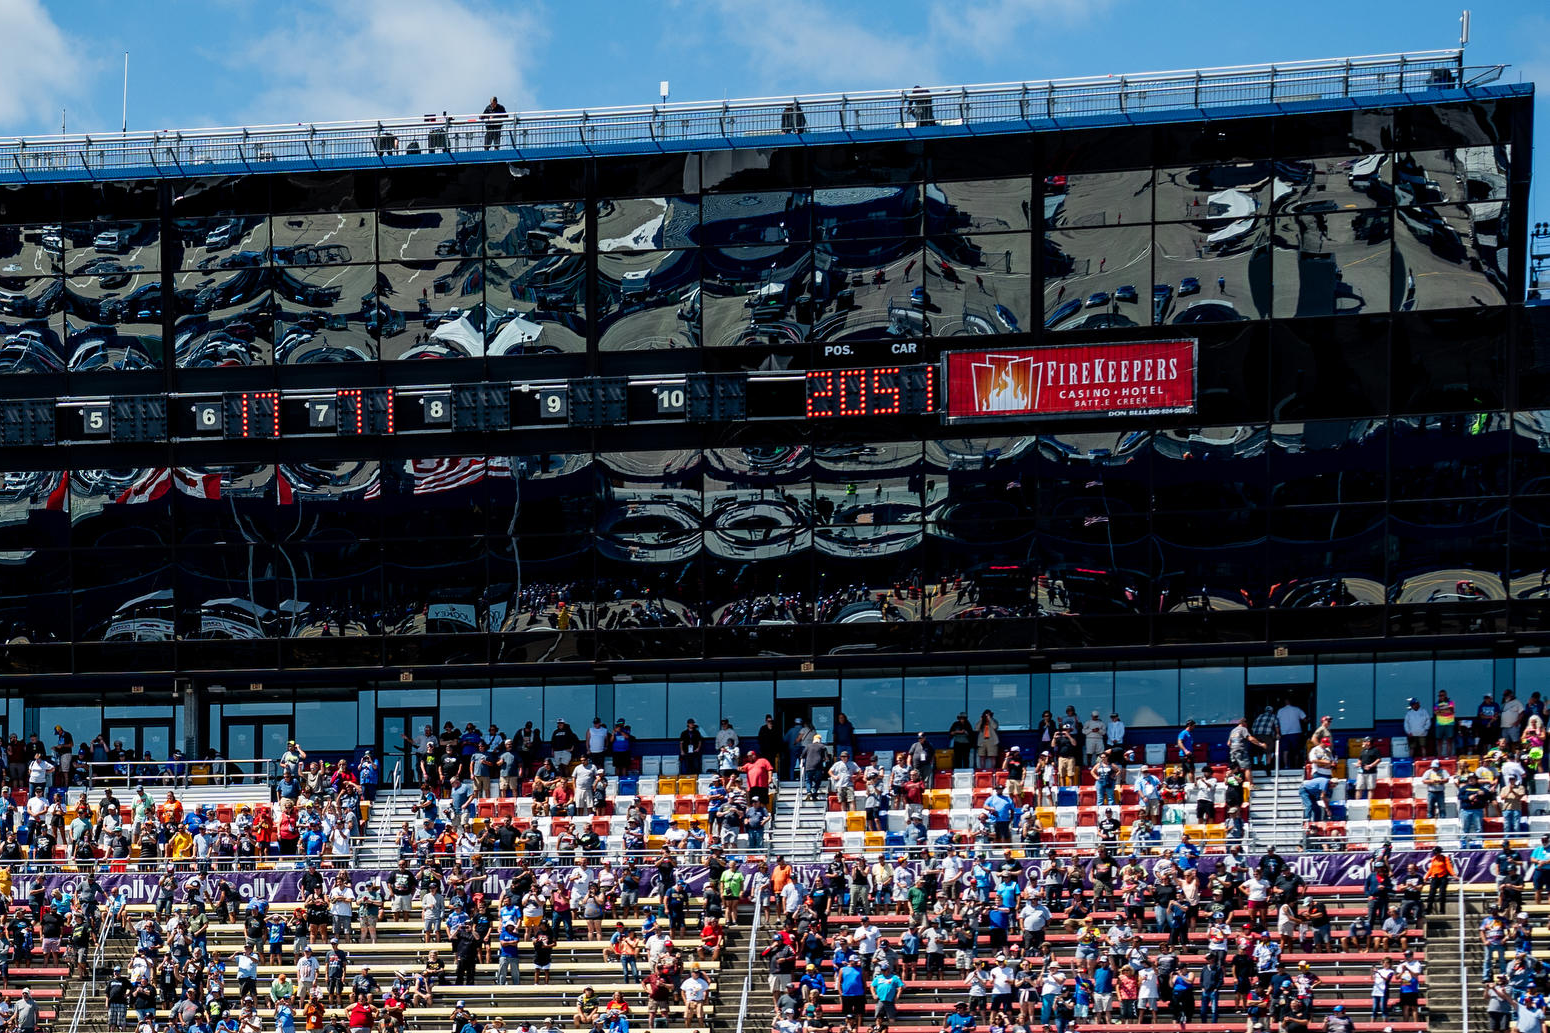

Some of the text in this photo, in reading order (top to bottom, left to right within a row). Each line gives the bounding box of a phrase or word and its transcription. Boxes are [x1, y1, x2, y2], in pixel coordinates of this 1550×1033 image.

[824, 345, 854, 356] POS.
[891, 343, 917, 354] CAR
[1047, 358, 1178, 386] FIREKEEPERS
[658, 390, 685, 408] 10
[1059, 386, 1164, 399] CASINO HOTEL
[1116, 396, 1148, 405] CREEK
[315, 404, 329, 422] 7
[430, 400, 444, 417] 8
[547, 396, 561, 413] 9
[90, 411, 103, 428] 5
[202, 408, 216, 425] 6
[118, 880, 159, 903] ally
[238, 877, 279, 901] ally
